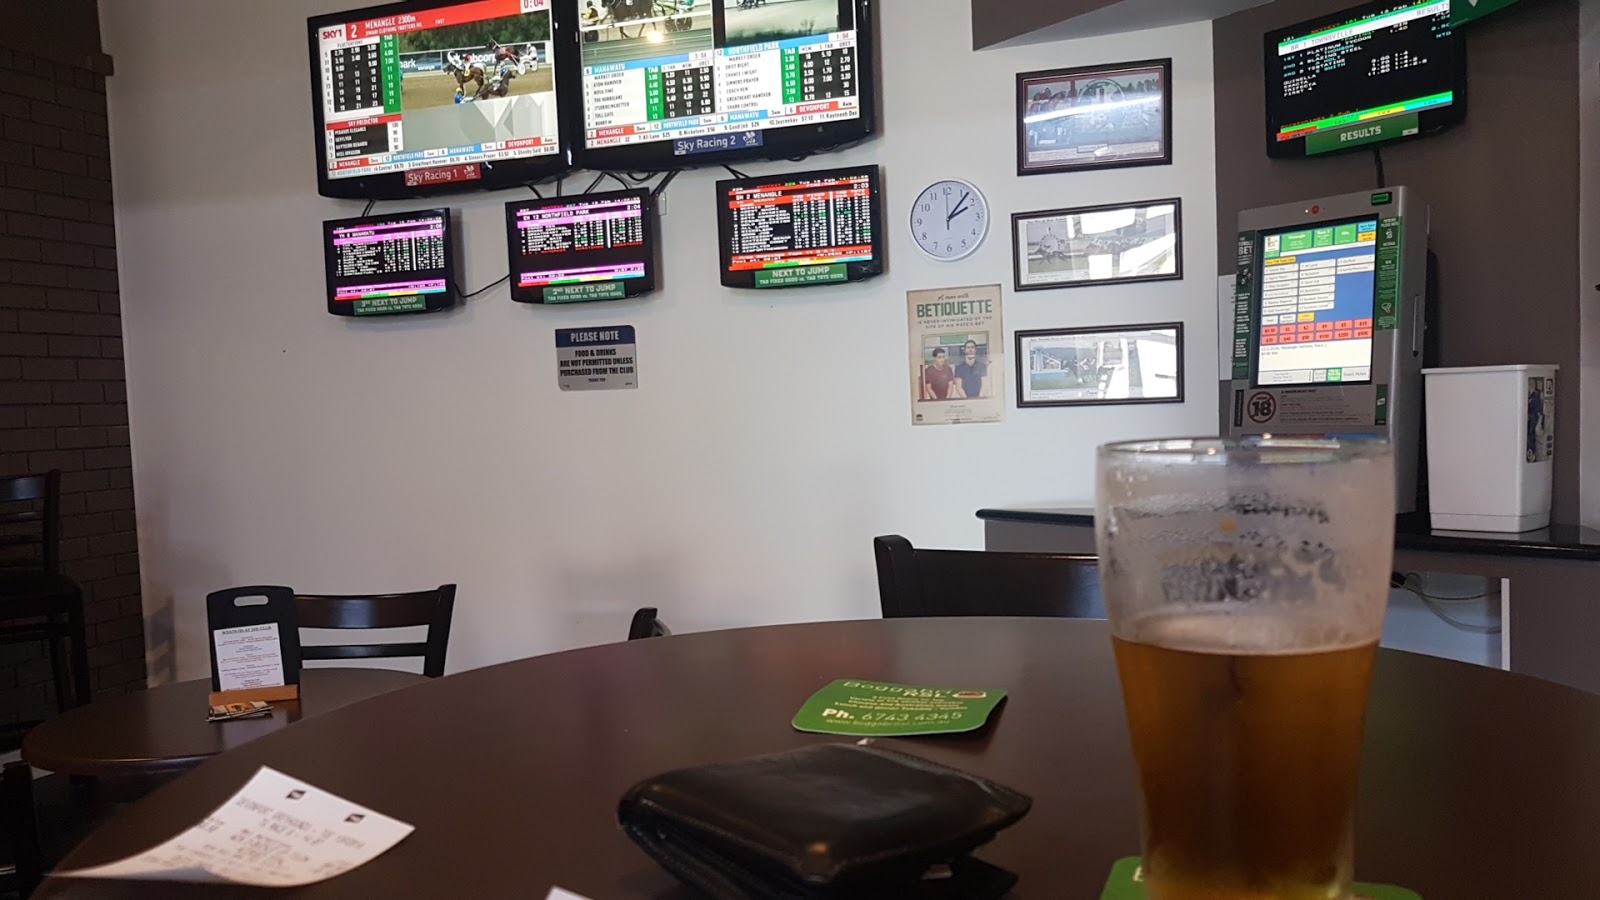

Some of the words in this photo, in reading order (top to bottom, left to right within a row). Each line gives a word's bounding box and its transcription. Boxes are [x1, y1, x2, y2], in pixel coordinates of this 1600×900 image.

[365, 17, 395, 30] MENANGLE
[399, 15, 416, 24] 2300m
[323, 29, 342, 39] SKY1
[351, 25, 357, 38] 2
[1312, 29, 1353, 44] TOWNSVILLE
[1307, 43, 1341, 55] PLATINUM
[1345, 35, 1371, 45] TYCOON
[1341, 46, 1363, 55] STEEL
[595, 65, 625, 73] MANAWATU
[1283, 74, 1316, 85] QUINELLA
[1284, 80, 1308, 89] EXACTA
[1284, 82, 1316, 93] TRIFECTA
[1284, 89, 1304, 97] FIRST
[800, 103, 830, 112] DEVONPORT
[1341, 126, 1381, 142] RESULTS
[508, 139, 534, 147] DEVONPORT
[678, 141, 694, 151] Sky
[697, 138, 728, 149] Racing
[730, 136, 735, 144] 2
[409, 174, 422, 182] Sky
[425, 171, 451, 180] Racing
[943, 187, 951, 195] 12
[970, 198, 975, 206] 2
[976, 213, 980, 221] 3
[947, 244, 952, 252] 6
[961, 239, 966, 247] 5
[1238, 246, 1253, 254] BET
[917, 300, 992, 318] BETIQUETTE
[571, 332, 597, 342] PLEASE
[599, 331, 619, 340] NOTE
[1252, 401, 1271, 416] 18
[822, 708, 854, 720] Ph.
[862, 713, 908, 721] 6743
[915, 712, 962, 720] 4345
